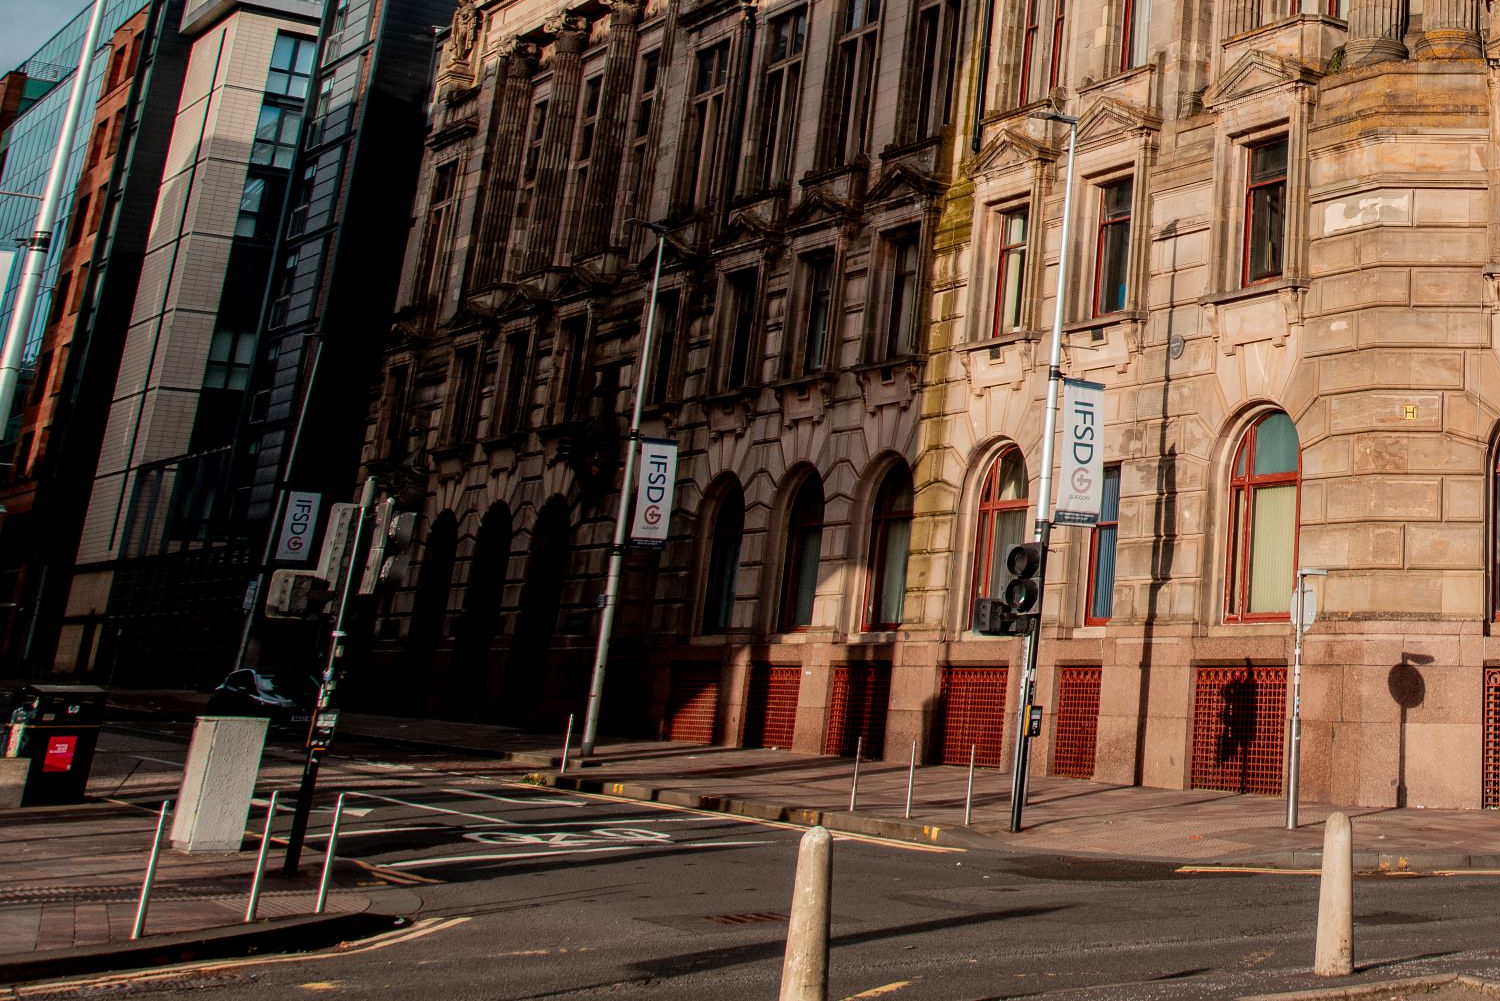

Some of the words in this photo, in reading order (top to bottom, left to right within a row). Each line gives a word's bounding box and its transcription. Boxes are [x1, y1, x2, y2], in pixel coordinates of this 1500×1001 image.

[1073, 400, 1094, 465] IFSD
[646, 454, 668, 503] IFSD
[290, 499, 312, 535] IFSD
